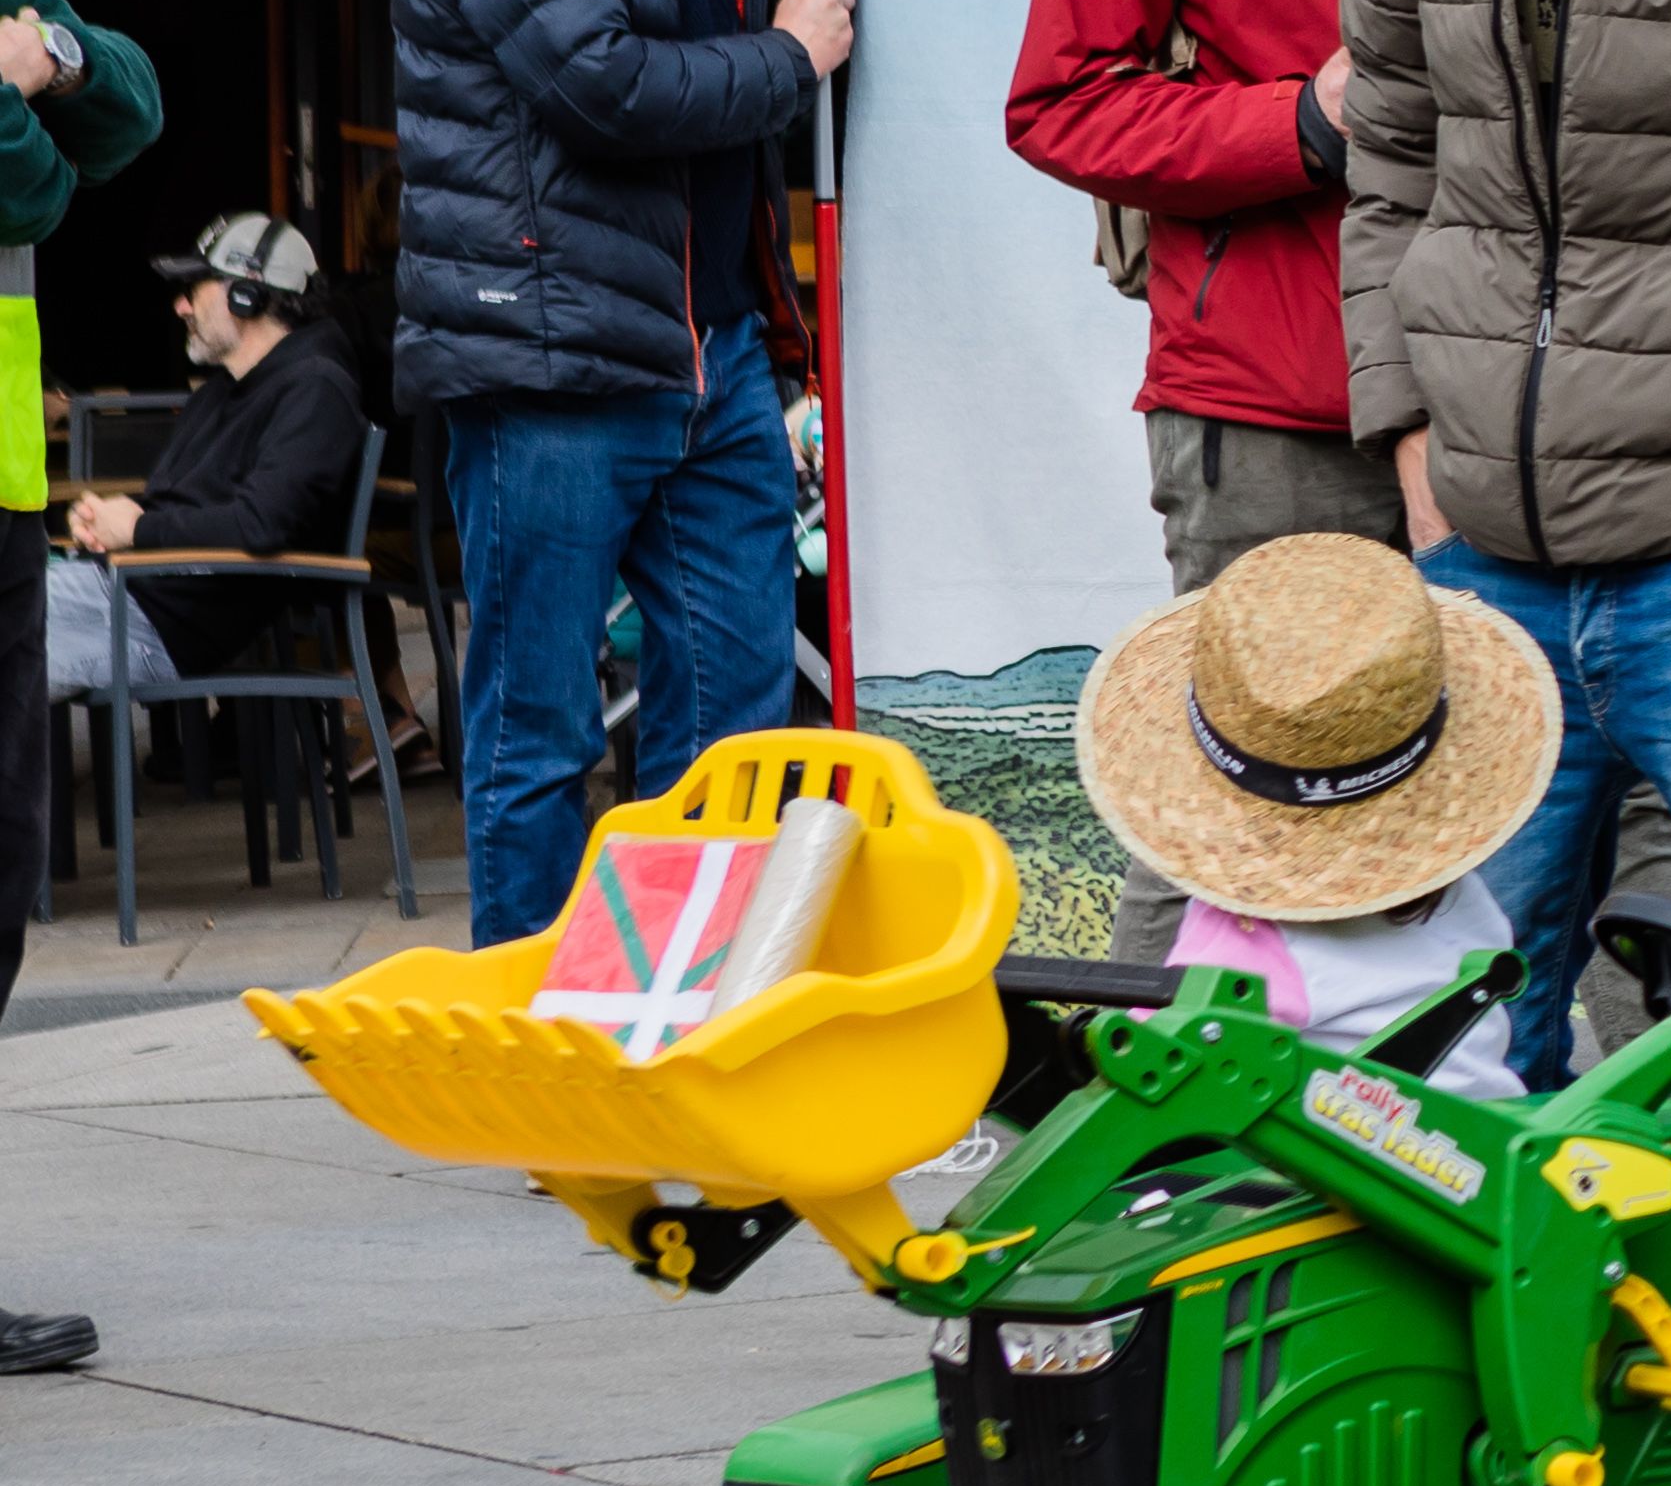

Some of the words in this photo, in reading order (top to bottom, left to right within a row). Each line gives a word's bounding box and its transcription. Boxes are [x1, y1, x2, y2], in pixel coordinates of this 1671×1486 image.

[1336, 734, 1429, 793] MICHELIN
[1340, 1069, 1406, 1124] rolly
[1311, 1083, 1379, 1143] trac
[1381, 1114, 1477, 1194] lader
